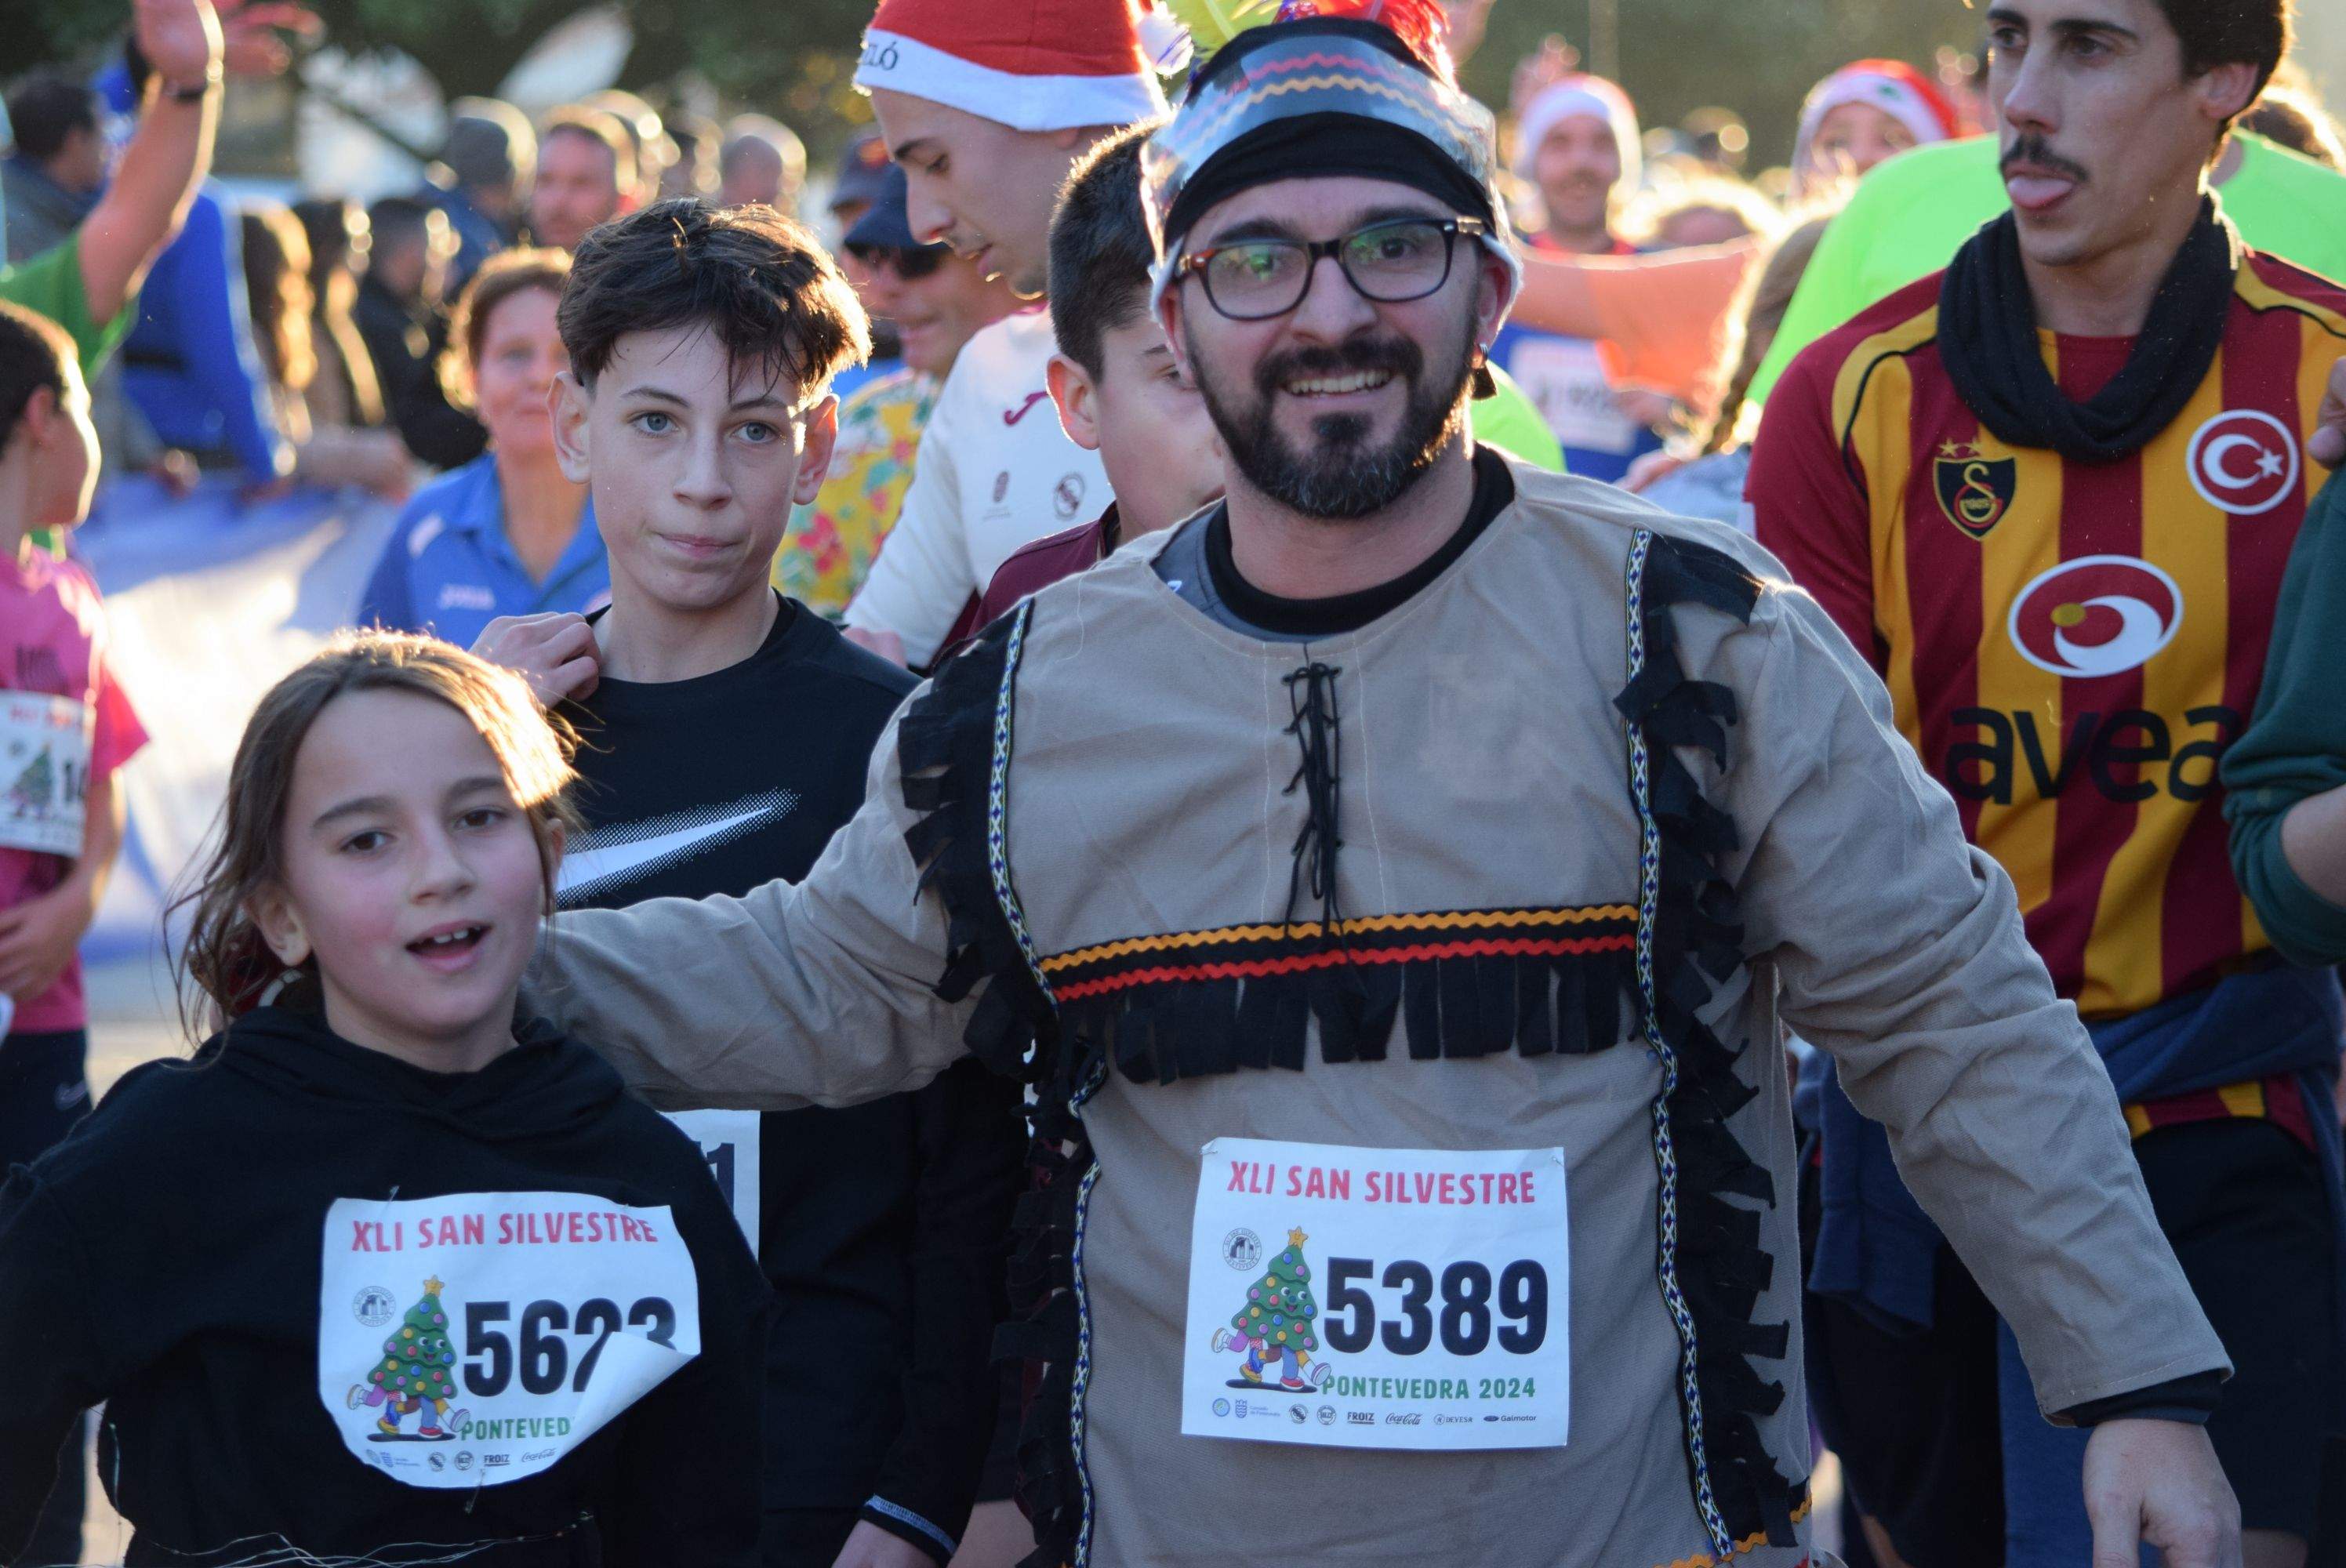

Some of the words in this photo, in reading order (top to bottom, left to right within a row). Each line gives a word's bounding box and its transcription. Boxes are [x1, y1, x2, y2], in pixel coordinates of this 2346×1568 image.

[1945, 706, 2241, 805] avea
[1227, 1160, 1275, 1195] XLI
[1286, 1165, 1350, 1201] SAN
[1364, 1171, 1536, 1204] SILVESTRE
[351, 1220, 404, 1253] XLI
[418, 1214, 485, 1249] SAN
[498, 1212, 659, 1245] SILVESTRE
[1324, 1256, 1549, 1356] 5389
[1322, 1375, 1469, 1399] PONTEVEDRA
[1479, 1377, 1535, 1399] 2024
[461, 1416, 574, 1441] PONTEVED
[1347, 1411, 1375, 1421] FROIZ
[484, 1454, 510, 1463] FROIZ
